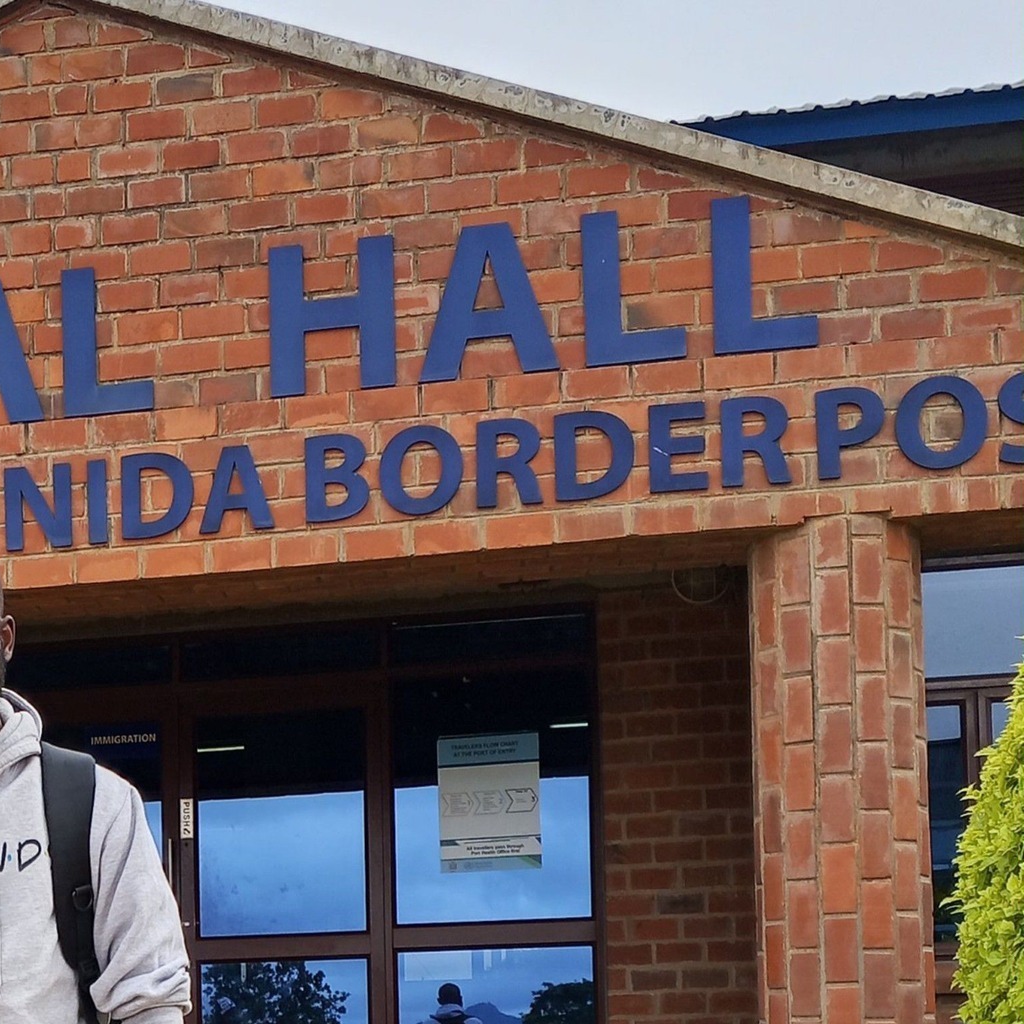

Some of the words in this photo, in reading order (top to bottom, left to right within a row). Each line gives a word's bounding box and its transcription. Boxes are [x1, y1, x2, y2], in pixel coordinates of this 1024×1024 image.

[269, 195, 818, 398] HALL
[304, 395, 792, 523] BORDER
[90, 733, 157, 746] IMMIGRATION
[182, 801, 191, 827] PUSH
